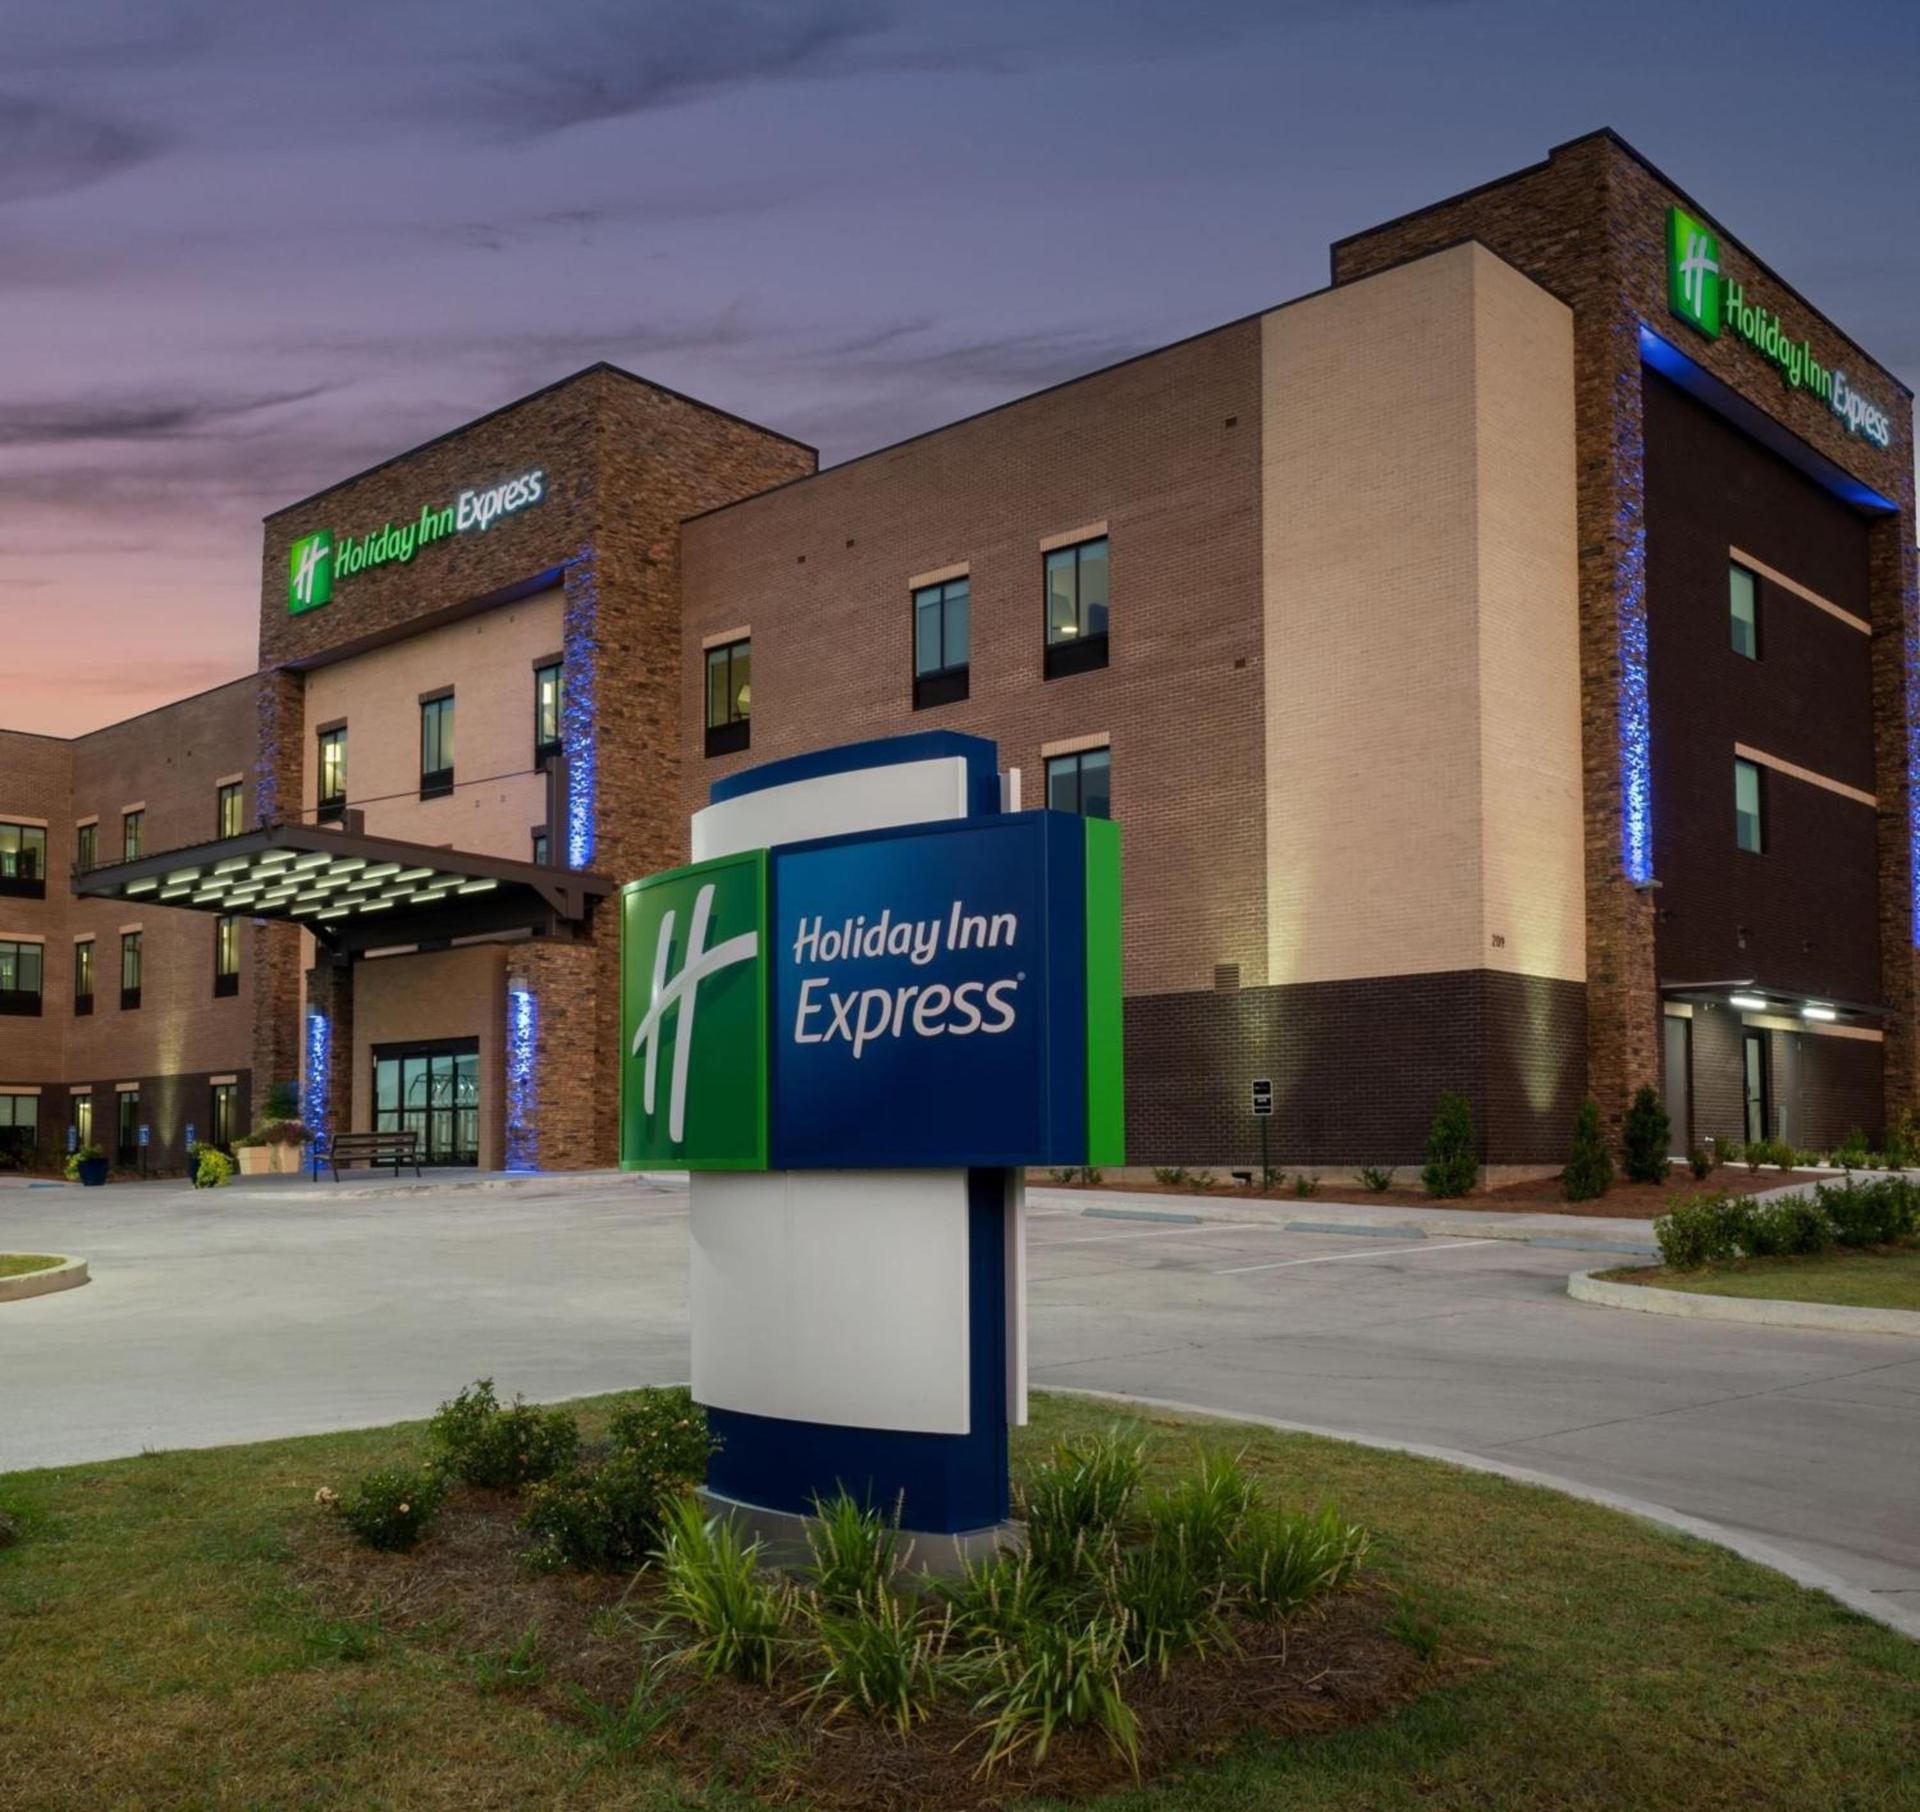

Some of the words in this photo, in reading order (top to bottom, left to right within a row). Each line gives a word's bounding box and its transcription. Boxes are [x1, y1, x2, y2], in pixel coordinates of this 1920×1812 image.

[1726, 277, 1802, 386] Holiday
[1803, 341, 1833, 400] Inn
[1832, 369, 1889, 447] Express
[334, 523, 415, 579] Holiday
[418, 505, 455, 546] Inn
[455, 470, 544, 530] Express
[793, 909, 941, 965] Holiday
[946, 901, 1018, 951] Inn
[793, 976, 1019, 1060] Express
